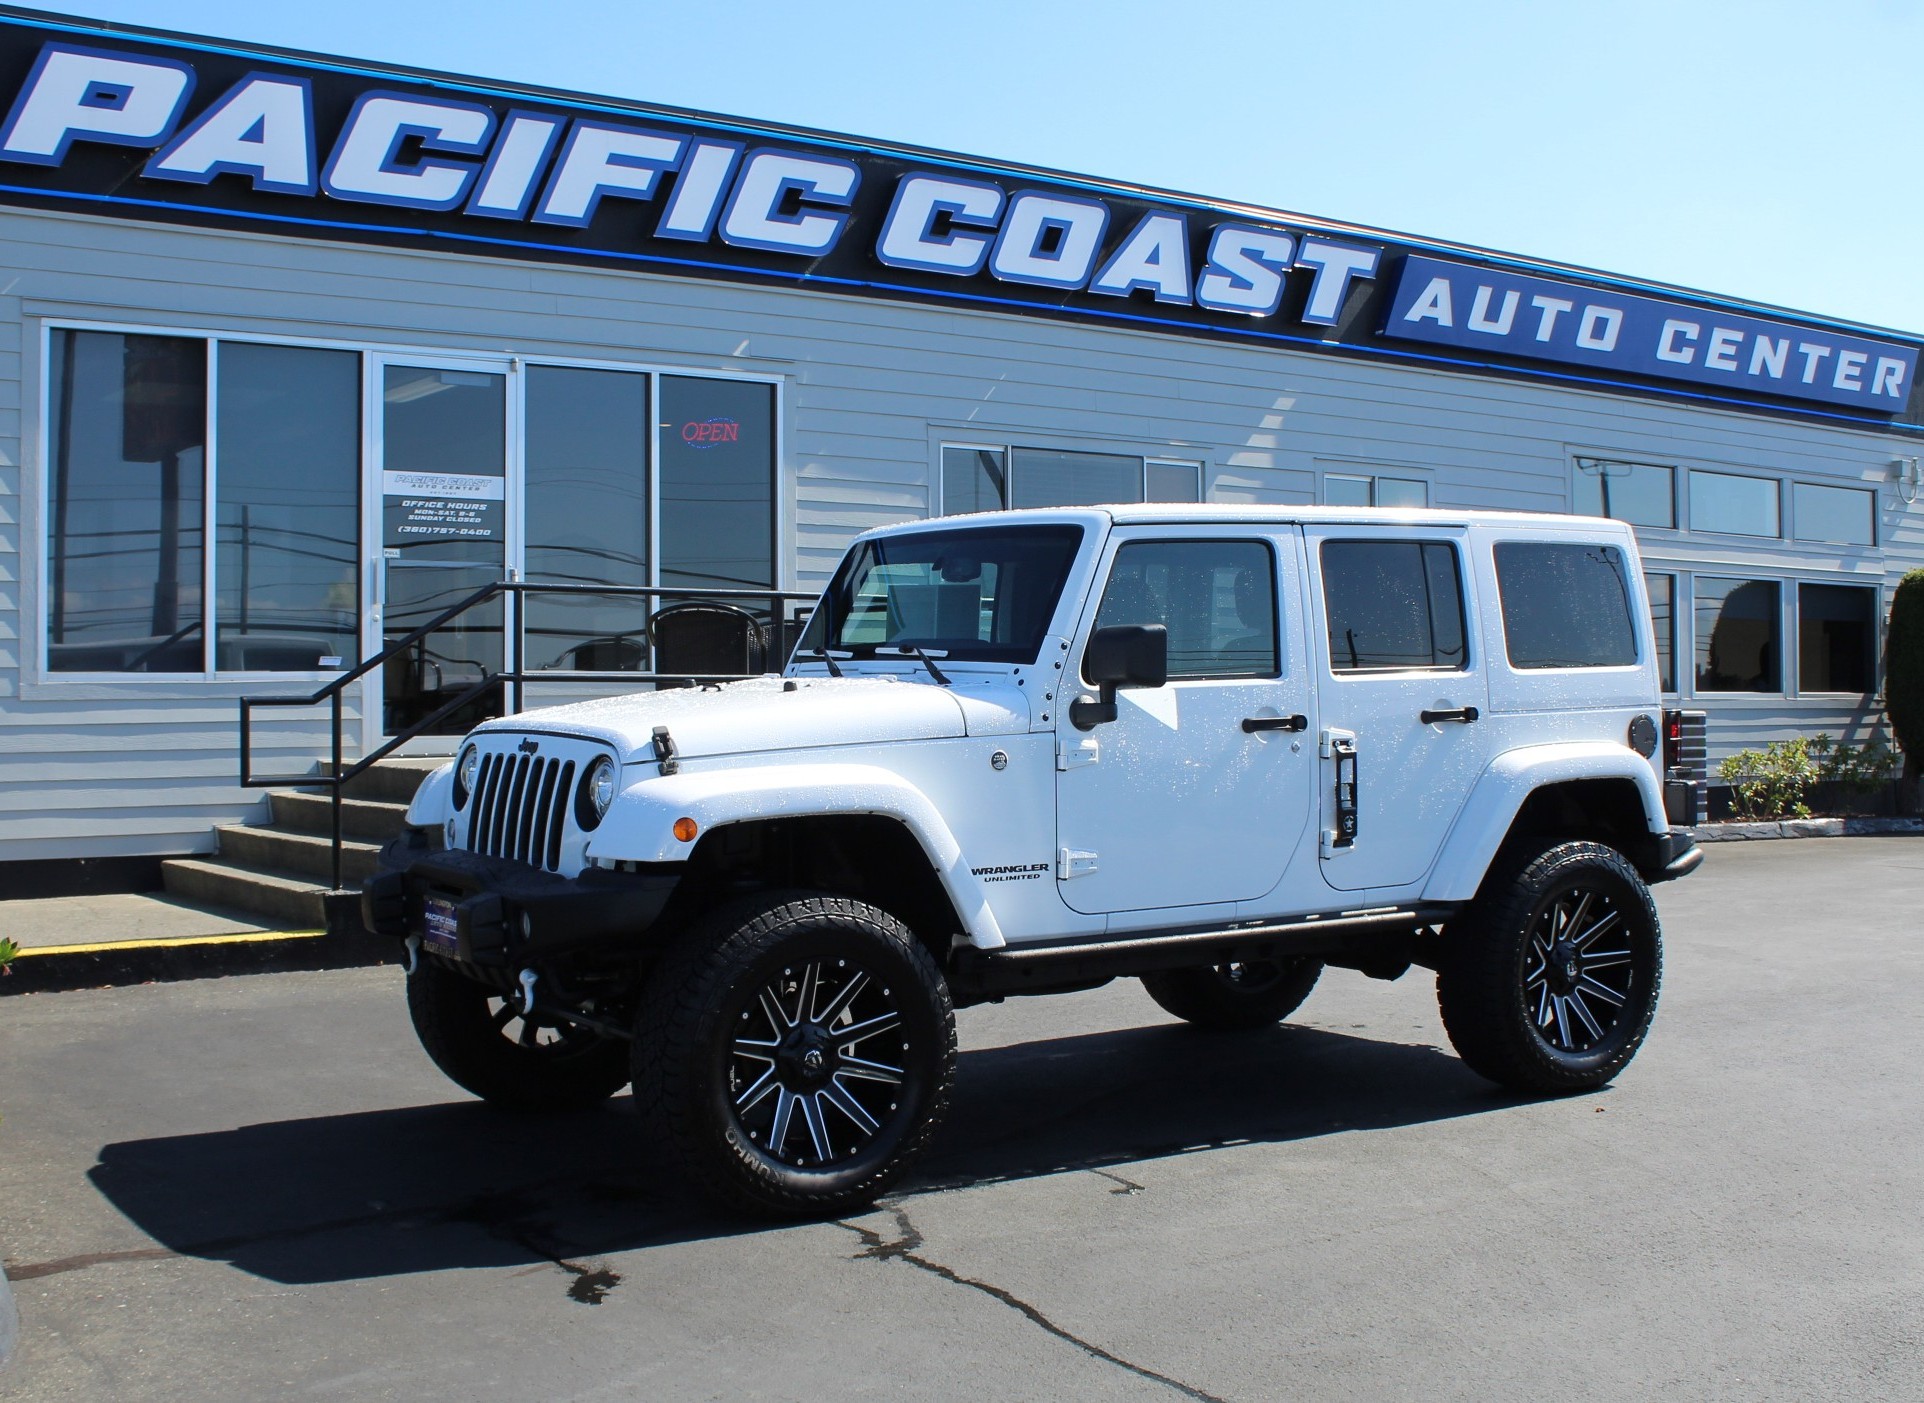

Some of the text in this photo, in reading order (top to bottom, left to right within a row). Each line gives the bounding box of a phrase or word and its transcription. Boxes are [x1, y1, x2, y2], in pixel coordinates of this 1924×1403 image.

[0, 41, 1383, 326] PACIFIC COAST
[1404, 277, 1908, 399] AUTO CENTER
[682, 422, 739, 441] OPEN
[395, 474, 492, 487] PACIFIC COAST
[402, 500, 487, 511] OFFICE HOURS
[518, 737, 539, 756] Jeep
[971, 863, 1049, 875] WRANGLER
[984, 873, 1040, 882] UNLIMITED
